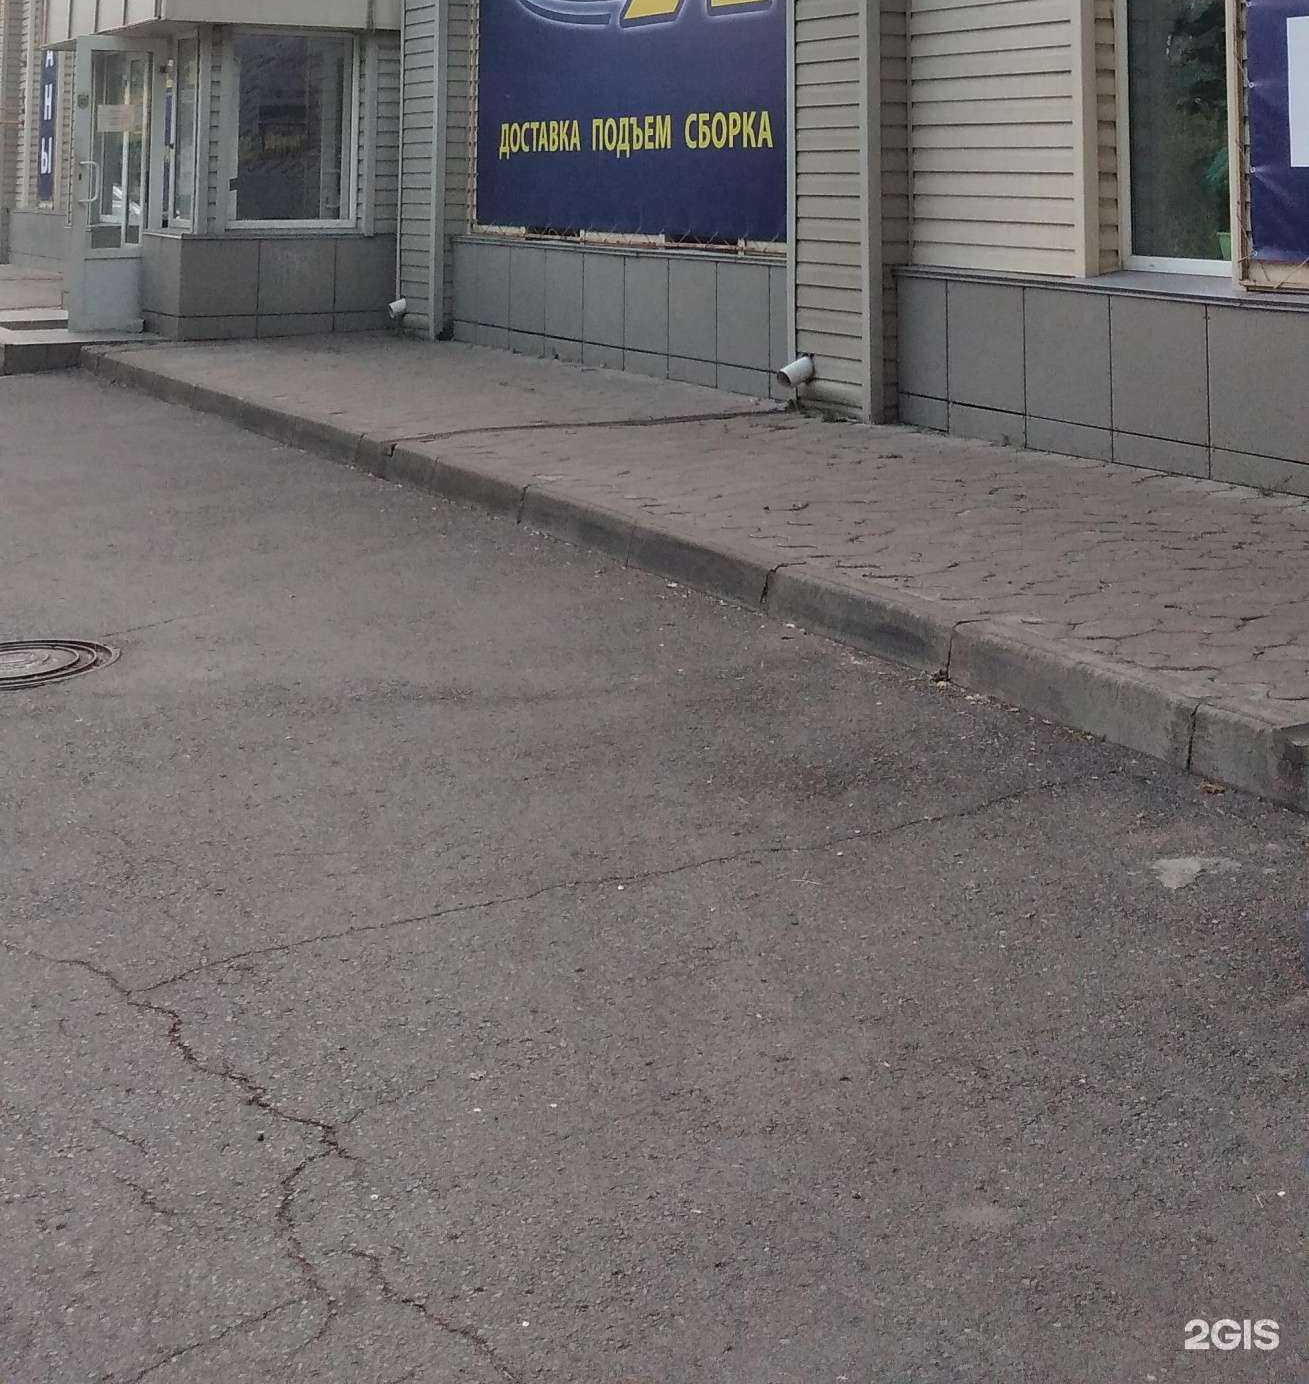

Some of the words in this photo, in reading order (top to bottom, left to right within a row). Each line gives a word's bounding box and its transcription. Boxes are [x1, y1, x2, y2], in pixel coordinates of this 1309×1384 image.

[498, 119, 581, 159] ДОСТАВКА
[592, 114, 671, 158] ПОДЪЕМ
[684, 111, 773, 149] СБОРКА
